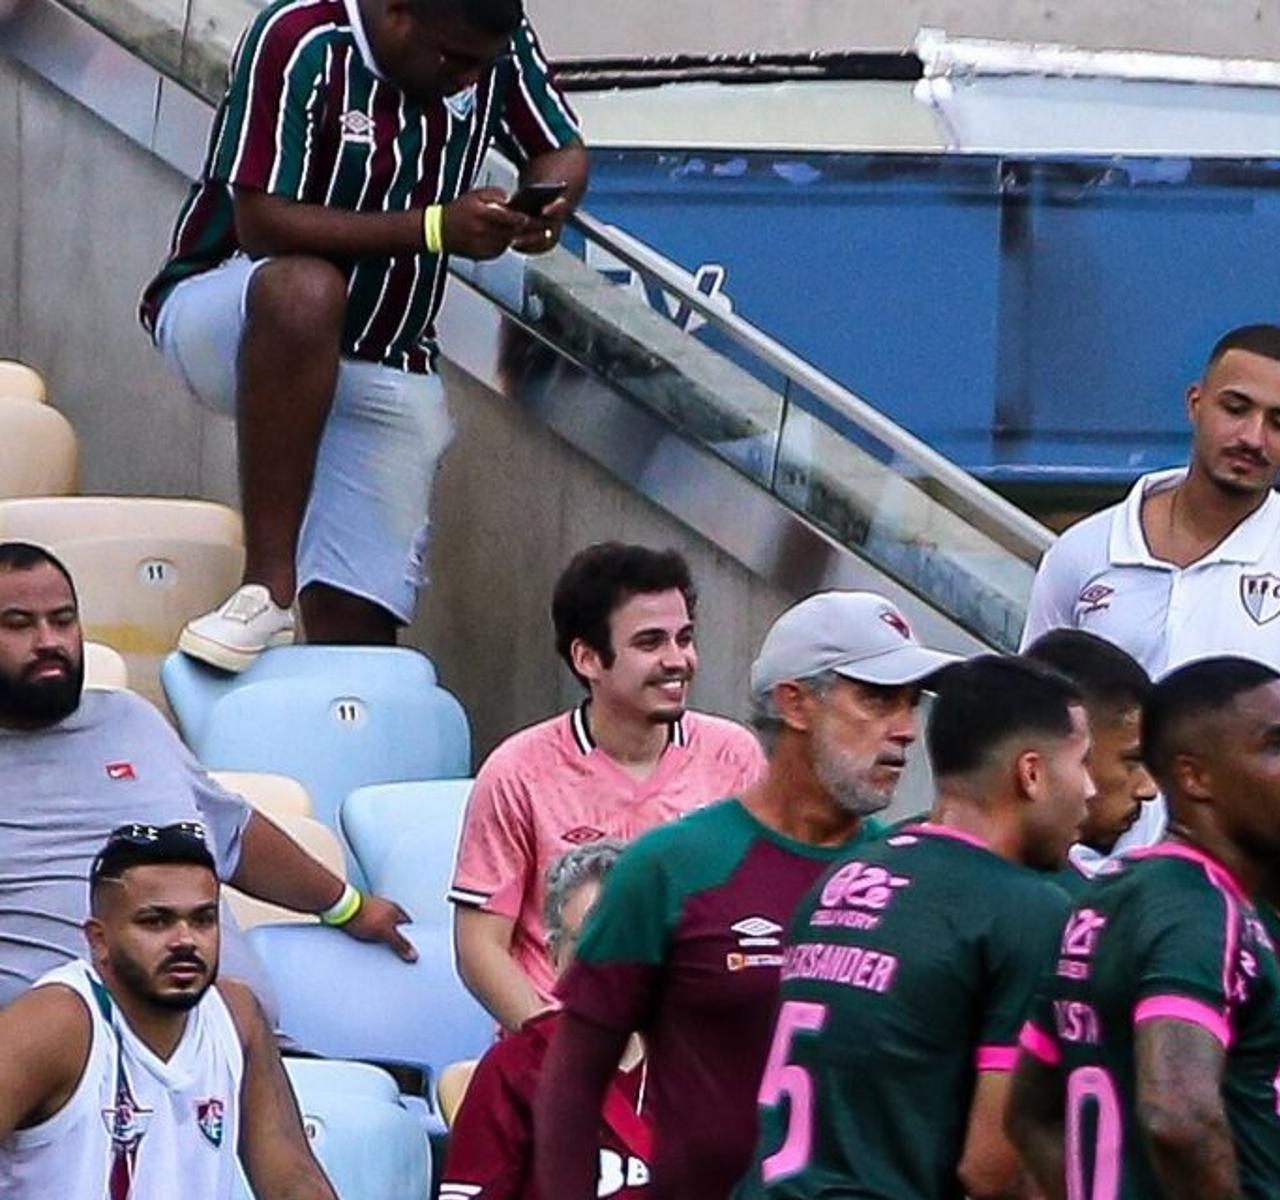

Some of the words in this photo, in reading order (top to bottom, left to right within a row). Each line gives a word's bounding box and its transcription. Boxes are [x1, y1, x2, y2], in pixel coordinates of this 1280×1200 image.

[149, 566, 163, 580] 11
[338, 705, 356, 721] 11
[757, 1000, 828, 1184] 5
